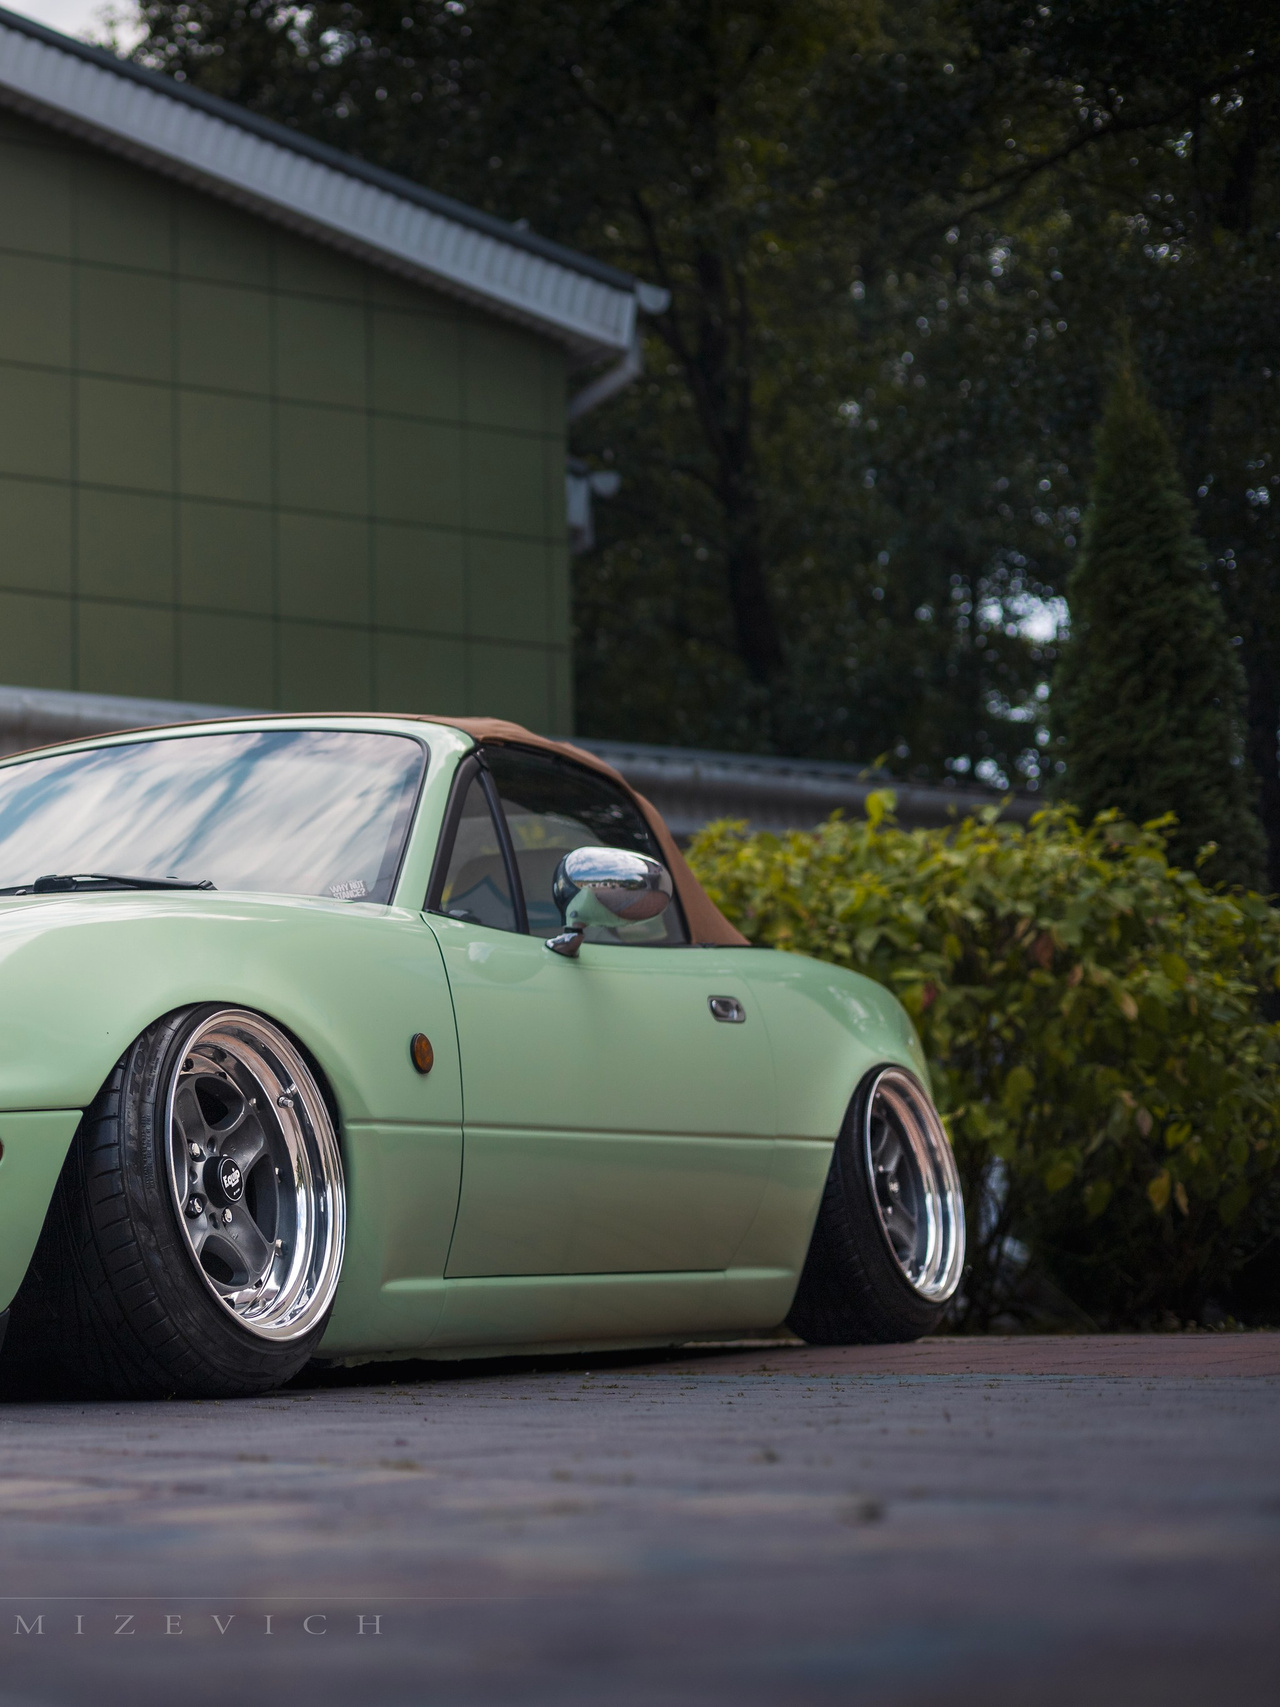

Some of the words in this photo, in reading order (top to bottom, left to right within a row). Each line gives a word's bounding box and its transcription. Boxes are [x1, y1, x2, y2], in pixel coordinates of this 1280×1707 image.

[329, 883, 348, 893] WHY
[349, 880, 364, 890] NOT
[333, 888, 366, 899] STANCE?
